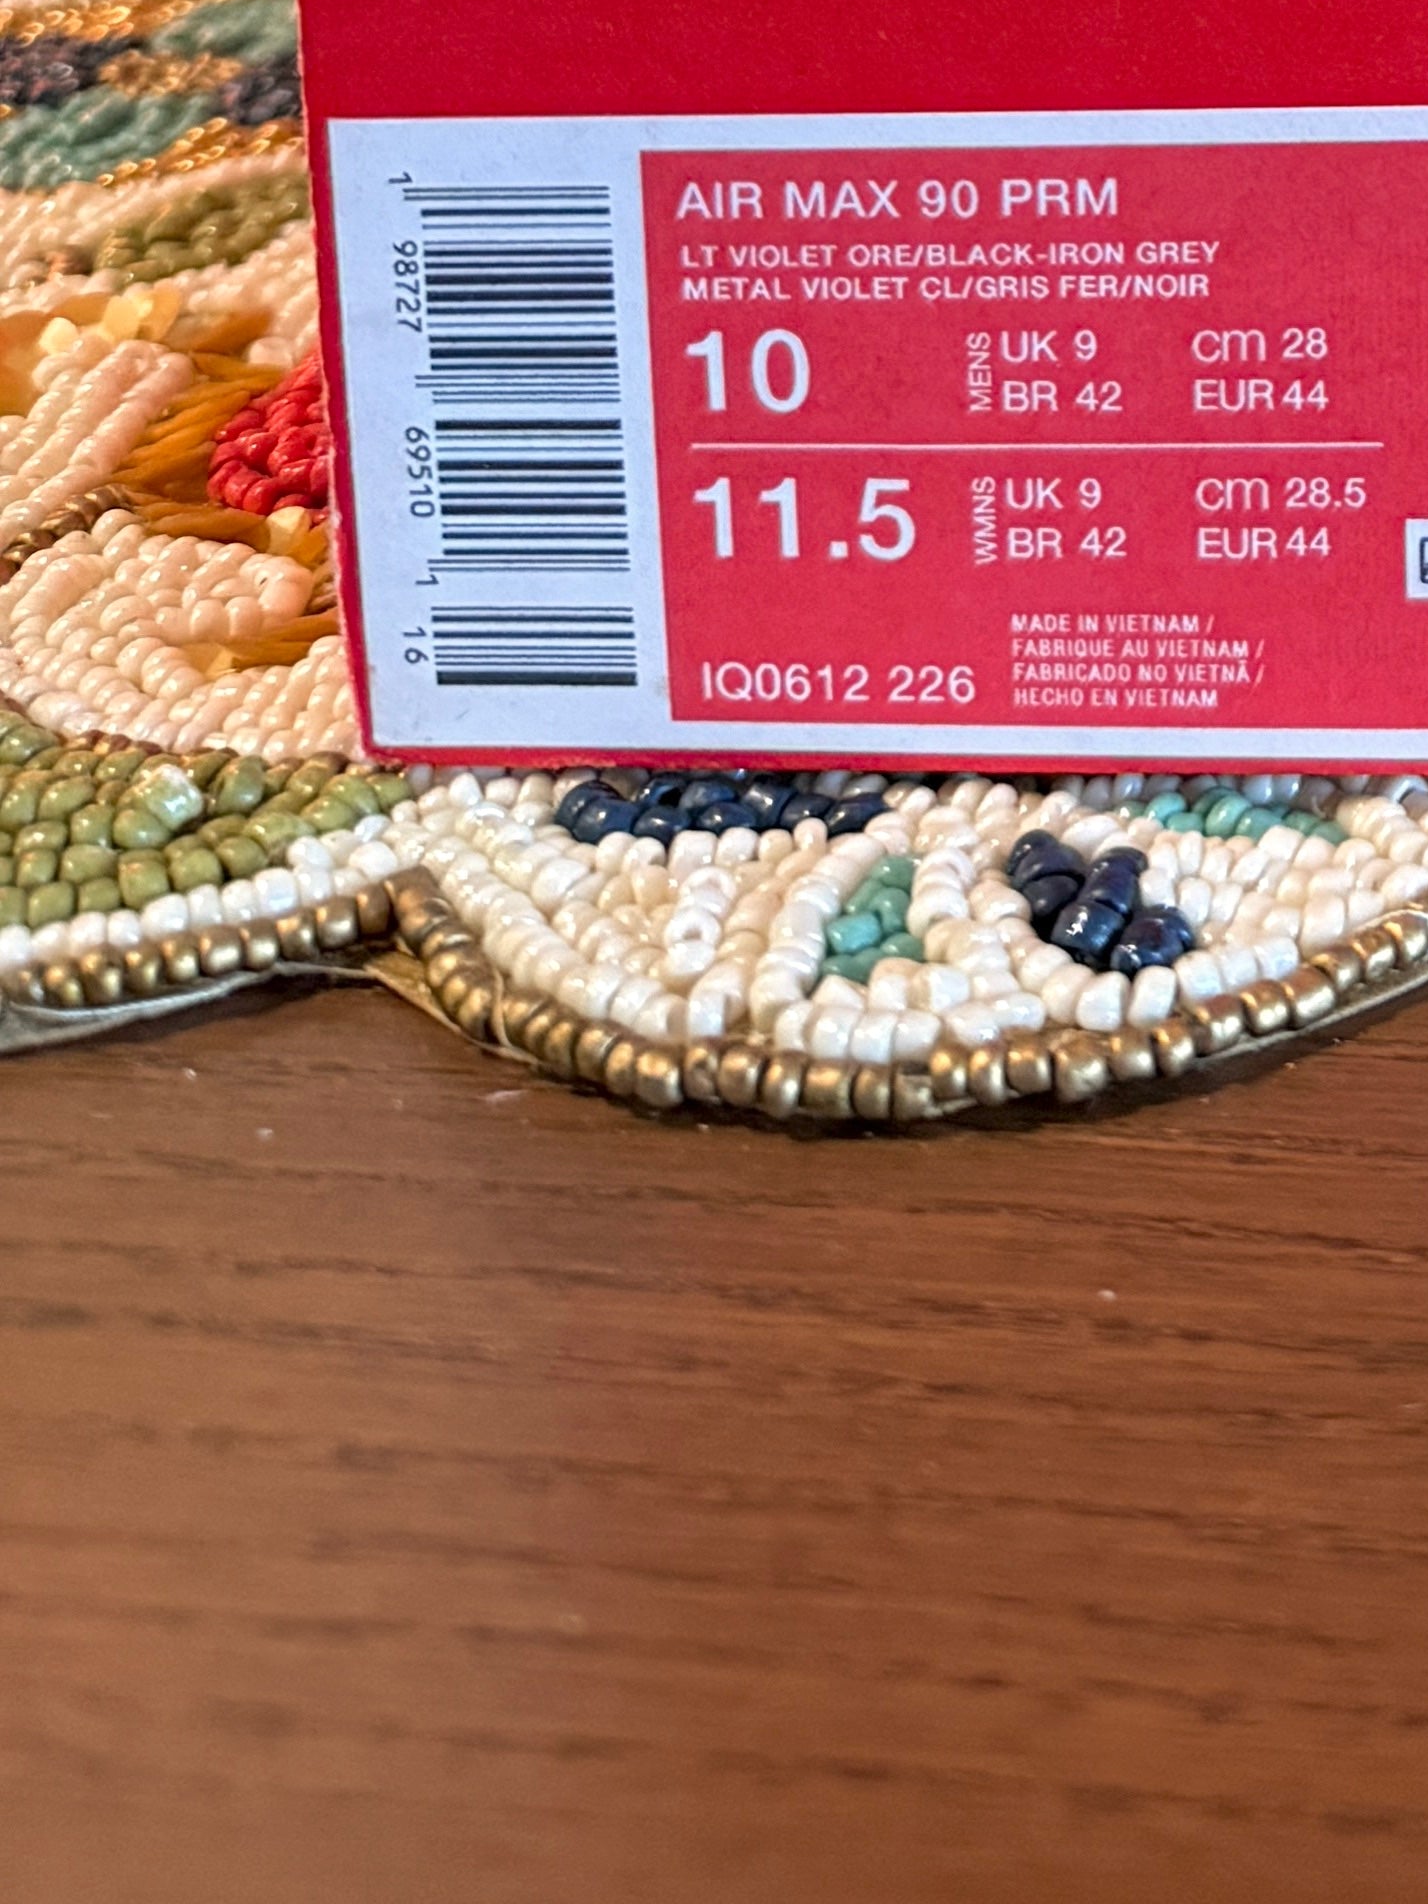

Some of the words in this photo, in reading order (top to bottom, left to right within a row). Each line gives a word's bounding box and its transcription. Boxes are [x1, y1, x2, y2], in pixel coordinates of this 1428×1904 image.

[676, 181, 763, 219] AIR
[784, 180, 900, 218] MAX
[920, 179, 978, 218] 90
[1001, 178, 1118, 216] PRM
[681, 246, 718, 268] LT
[729, 245, 837, 268] VIOLET
[847, 243, 1125, 267] ORE/BLACK-IRON
[1136, 241, 1220, 264] GREY
[393, 240, 422, 333] 98727
[682, 277, 791, 301] METAL
[802, 277, 909, 300] VIOLET
[920, 275, 1049, 300] CL/GRIS
[1059, 274, 1210, 299] FER/NOIR
[1001, 330, 1057, 363] UK
[1074, 330, 1097, 361] 9
[1282, 327, 1328, 360] 28
[685, 328, 811, 413] 10
[966, 331, 993, 414] MENS
[1002, 381, 1058, 412] BR
[1075, 381, 1123, 411] 42
[1193, 379, 1274, 411] EUR
[1282, 380, 1329, 410] 44
[405, 426, 435, 518] 69510
[1005, 478, 1063, 510] UK
[1079, 478, 1102, 509] 9
[1285, 477, 1366, 509] 28.5
[693, 477, 916, 560] 11.5
[972, 476, 997, 565] WMNS
[1007, 529, 1063, 560] BR
[1080, 527, 1127, 558] 42
[1197, 528, 1278, 559] EUR
[1285, 528, 1331, 557] 44
[1010, 614, 1070, 633] MADE
[1077, 614, 1099, 633] IN
[1105, 614, 1200, 633] VIETNAM
[1011, 639, 1115, 659] FABRIQUE
[1121, 639, 1149, 658] AU
[1155, 639, 1250, 658] VIETNAM
[702, 661, 870, 702] IQ0612
[888, 664, 976, 704] 226
[1012, 663, 1132, 683] FABRICADO
[1138, 663, 1167, 682] NO
[1013, 688, 1084, 707] HECHO
[1090, 688, 1117, 707] EN
[1124, 688, 1218, 707] VIETNAM
